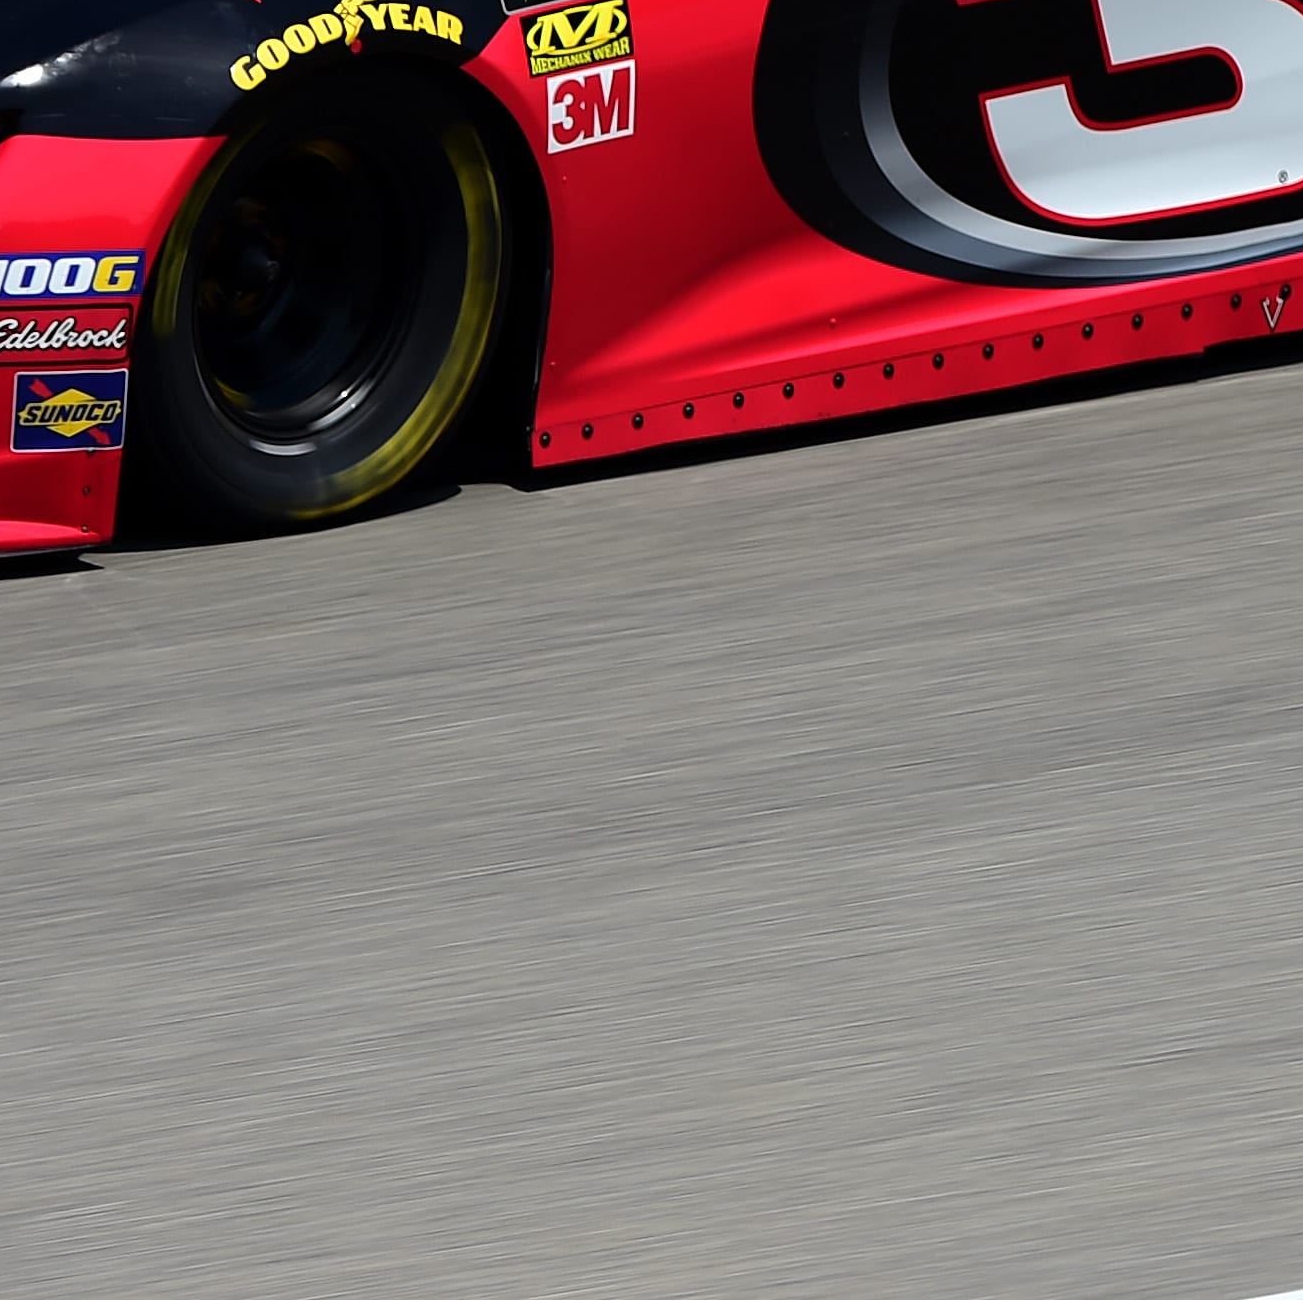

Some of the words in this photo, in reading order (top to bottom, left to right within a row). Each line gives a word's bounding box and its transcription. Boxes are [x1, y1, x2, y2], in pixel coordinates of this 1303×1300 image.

[530, 50, 592, 76] MECHANIX
[593, 36, 631, 61] WEAR
[552, 66, 631, 146] 3M
[23, 403, 119, 424] SUNOCO
